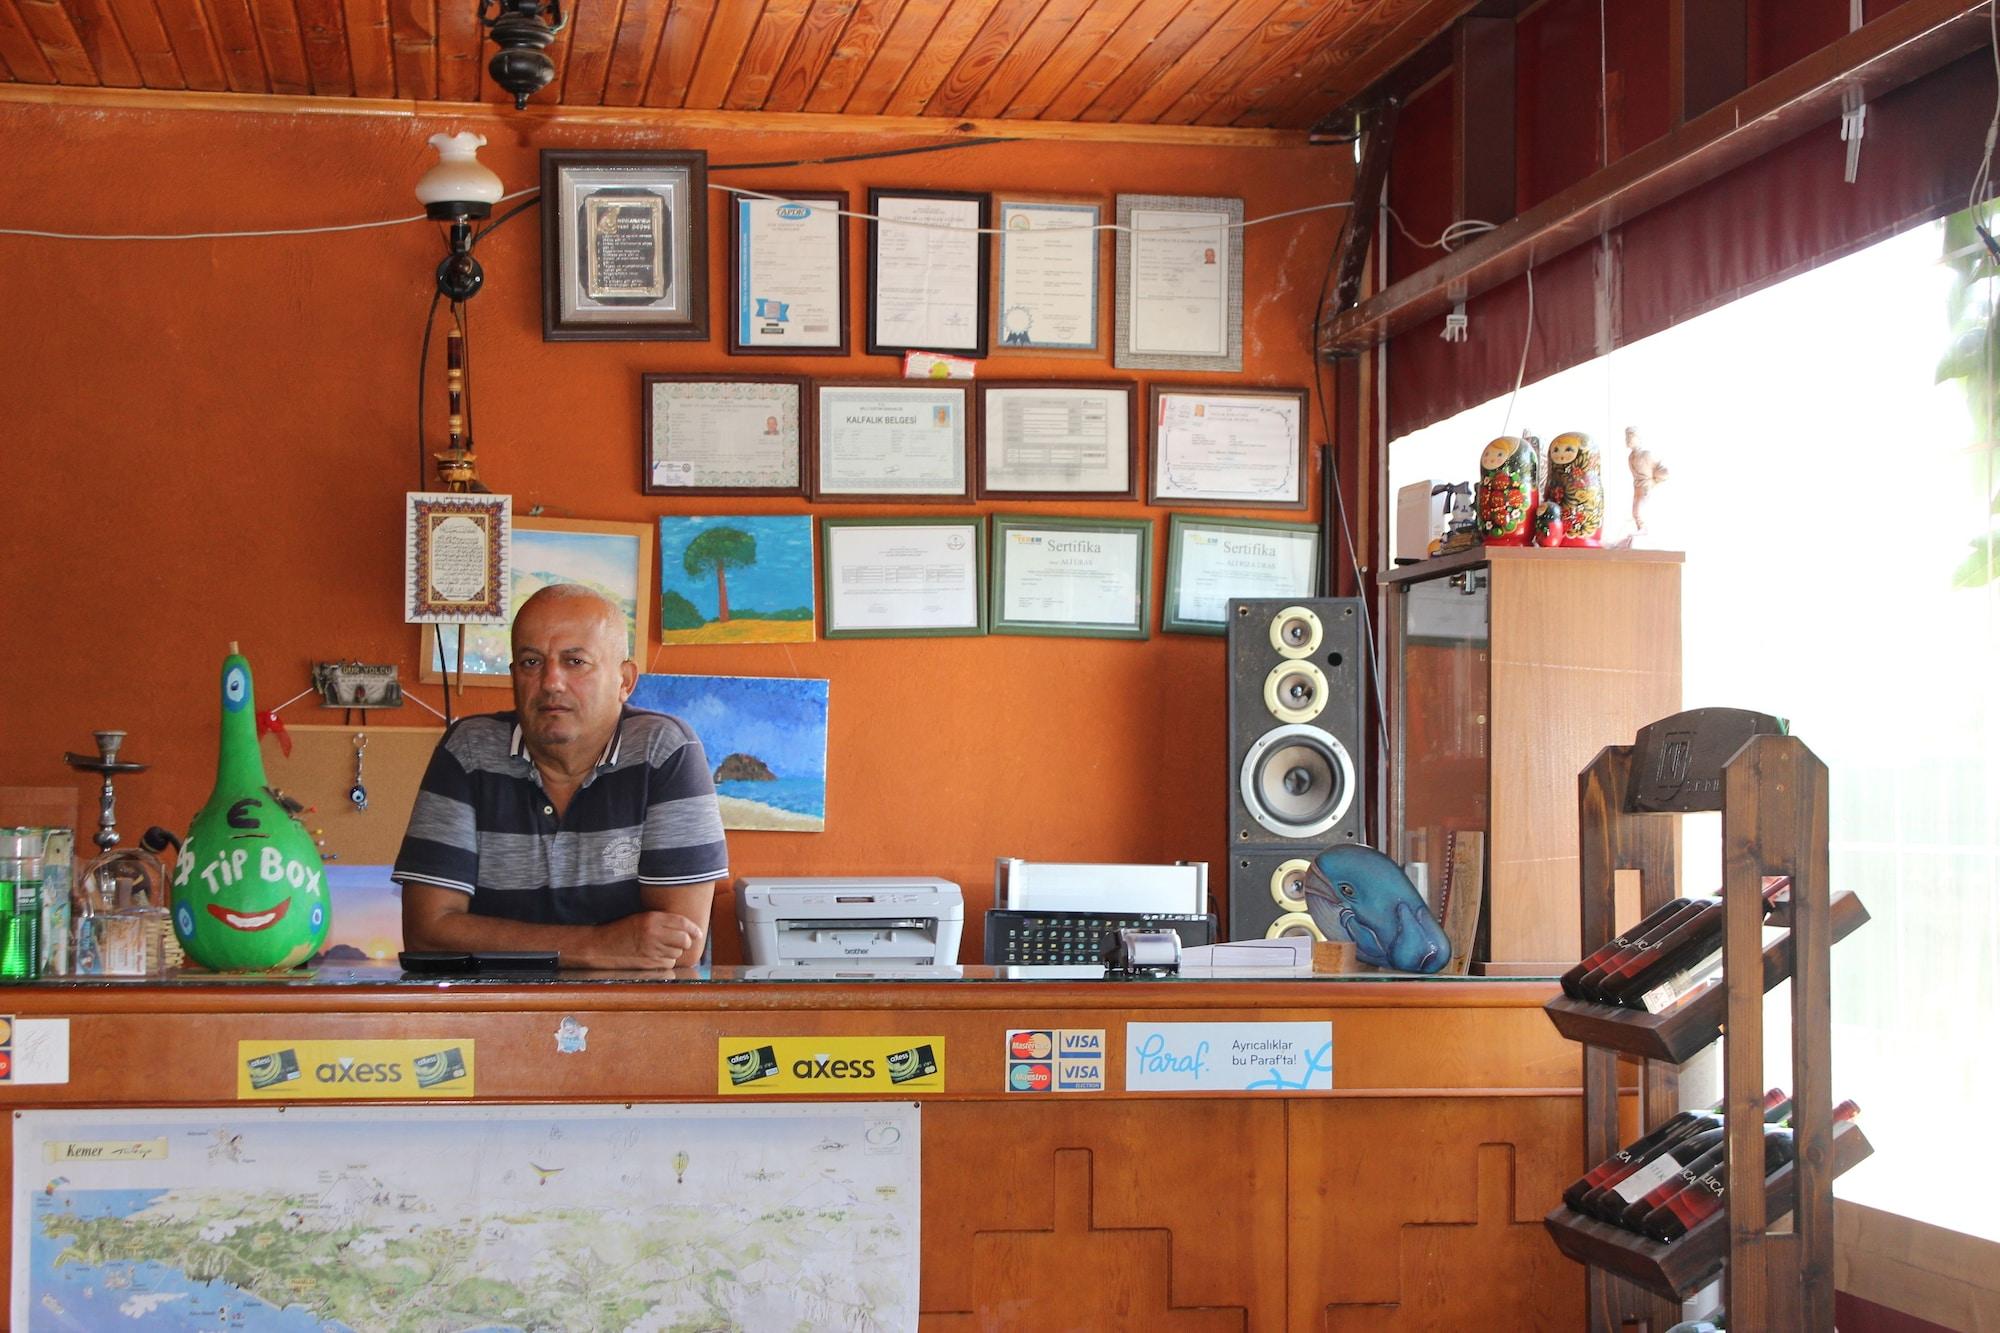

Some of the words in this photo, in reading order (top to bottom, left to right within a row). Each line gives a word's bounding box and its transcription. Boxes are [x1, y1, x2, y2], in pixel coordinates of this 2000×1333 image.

[846, 416, 883, 424] KALFALIK
[885, 415, 917, 424] BELGESİ
[1048, 540, 1102, 553] Sertifika
[1224, 541, 1276, 556] Sertifika
[1065, 1035, 1099, 1048] VISA
[1232, 1039, 1294, 1054] Ayrıcalıklar
[1232, 1055, 1247, 1065] bu
[1250, 1054, 1297, 1066] Paraf'ta!
[315, 1058, 402, 1083] axess
[793, 1055, 876, 1079] axess
[1065, 1066, 1099, 1079] VISA
[67, 1143, 103, 1157] Kemer
